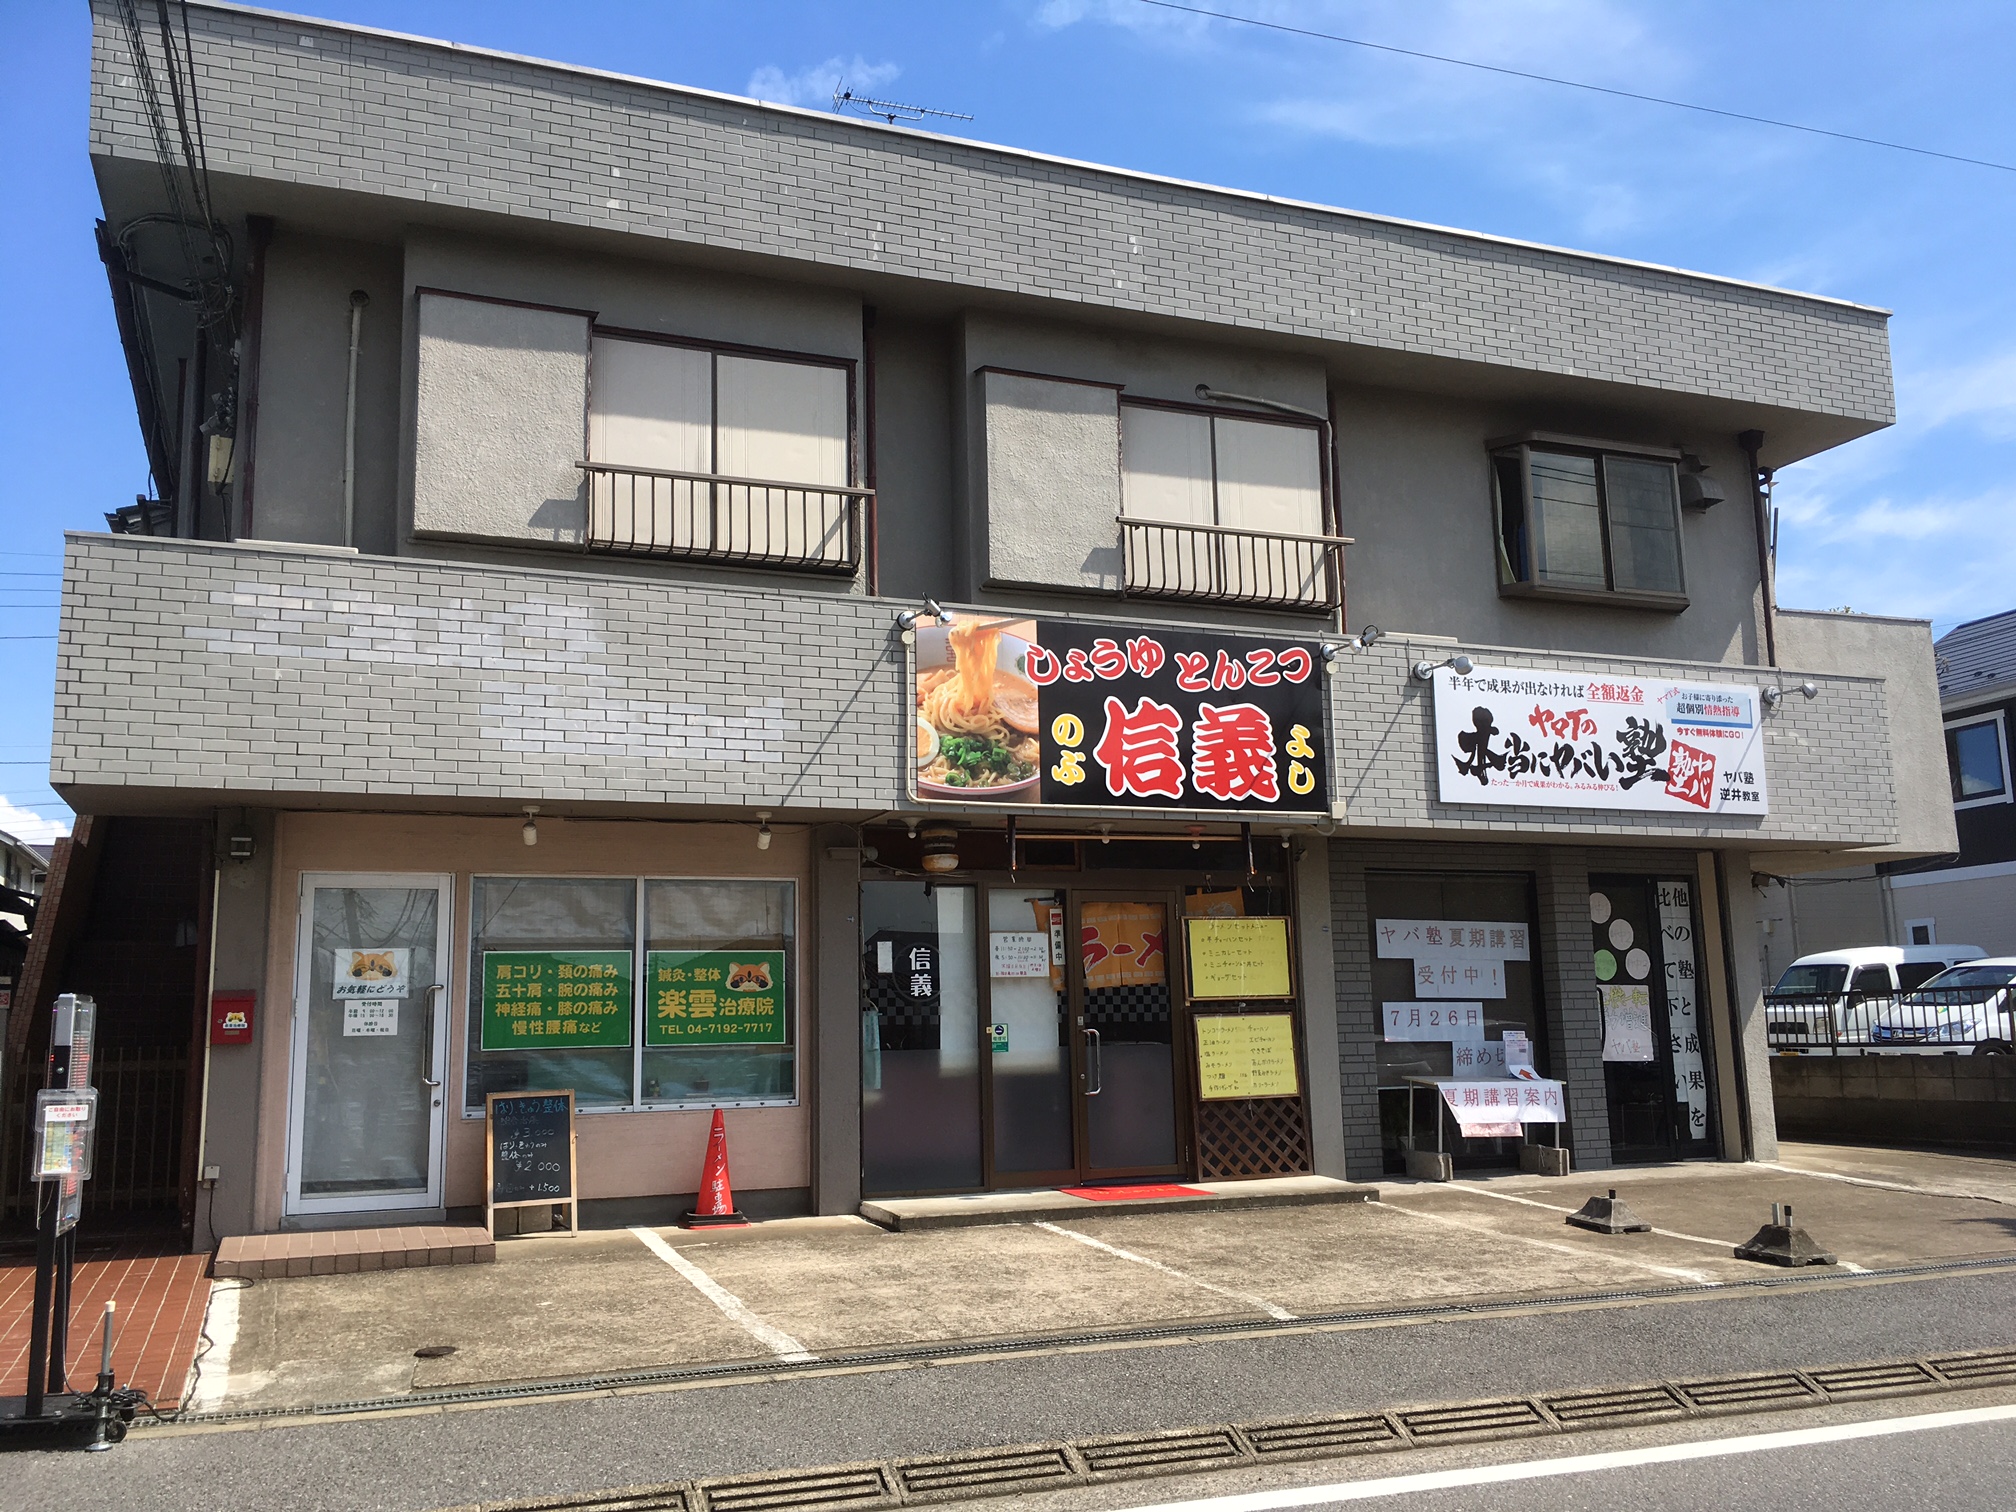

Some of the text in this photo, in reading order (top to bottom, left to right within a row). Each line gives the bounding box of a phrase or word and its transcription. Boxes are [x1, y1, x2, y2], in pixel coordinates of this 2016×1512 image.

[1024, 634, 1165, 686] しょうゆ
[1682, 692, 1734, 704] お子様に寄り添った
[1676, 702, 1740, 718] 超個別情熱指導
[1051, 713, 1085, 786] のぶ
[1092, 695, 1281, 802] 信義
[1451, 705, 1671, 791] 本当にヤバい塾
[1285, 724, 1315, 795] よし
[1723, 770, 1755, 785] ヤバ塾
[1719, 788, 1760, 802] 逆井教室
[1380, 925, 1526, 949] ヤバ塾夏期講習
[657, 968, 721, 982] 鍼灸・整体
[908, 947, 932, 997] 信義
[1417, 964, 1498, 986] 受付中！
[336, 984, 406, 994] お気軽にどうぞ
[495, 982, 619, 998] 五十肩・腕の痛み
[495, 1000, 619, 1017] 神経痛・膝の痛み
[657, 989, 774, 1019] 楽雲治療院
[1672, 887, 1706, 1127] 他の塾と成果を
[511, 1019, 602, 1036] 慢性腰痛など
[1390, 1008, 1478, 1028] 7月26日
[659, 1022, 773, 1035] TEL 04-7192-7717
[1612, 1039, 1641, 1054] ヤバ塾
[1443, 1086, 1558, 1107] 夏期講習案内
